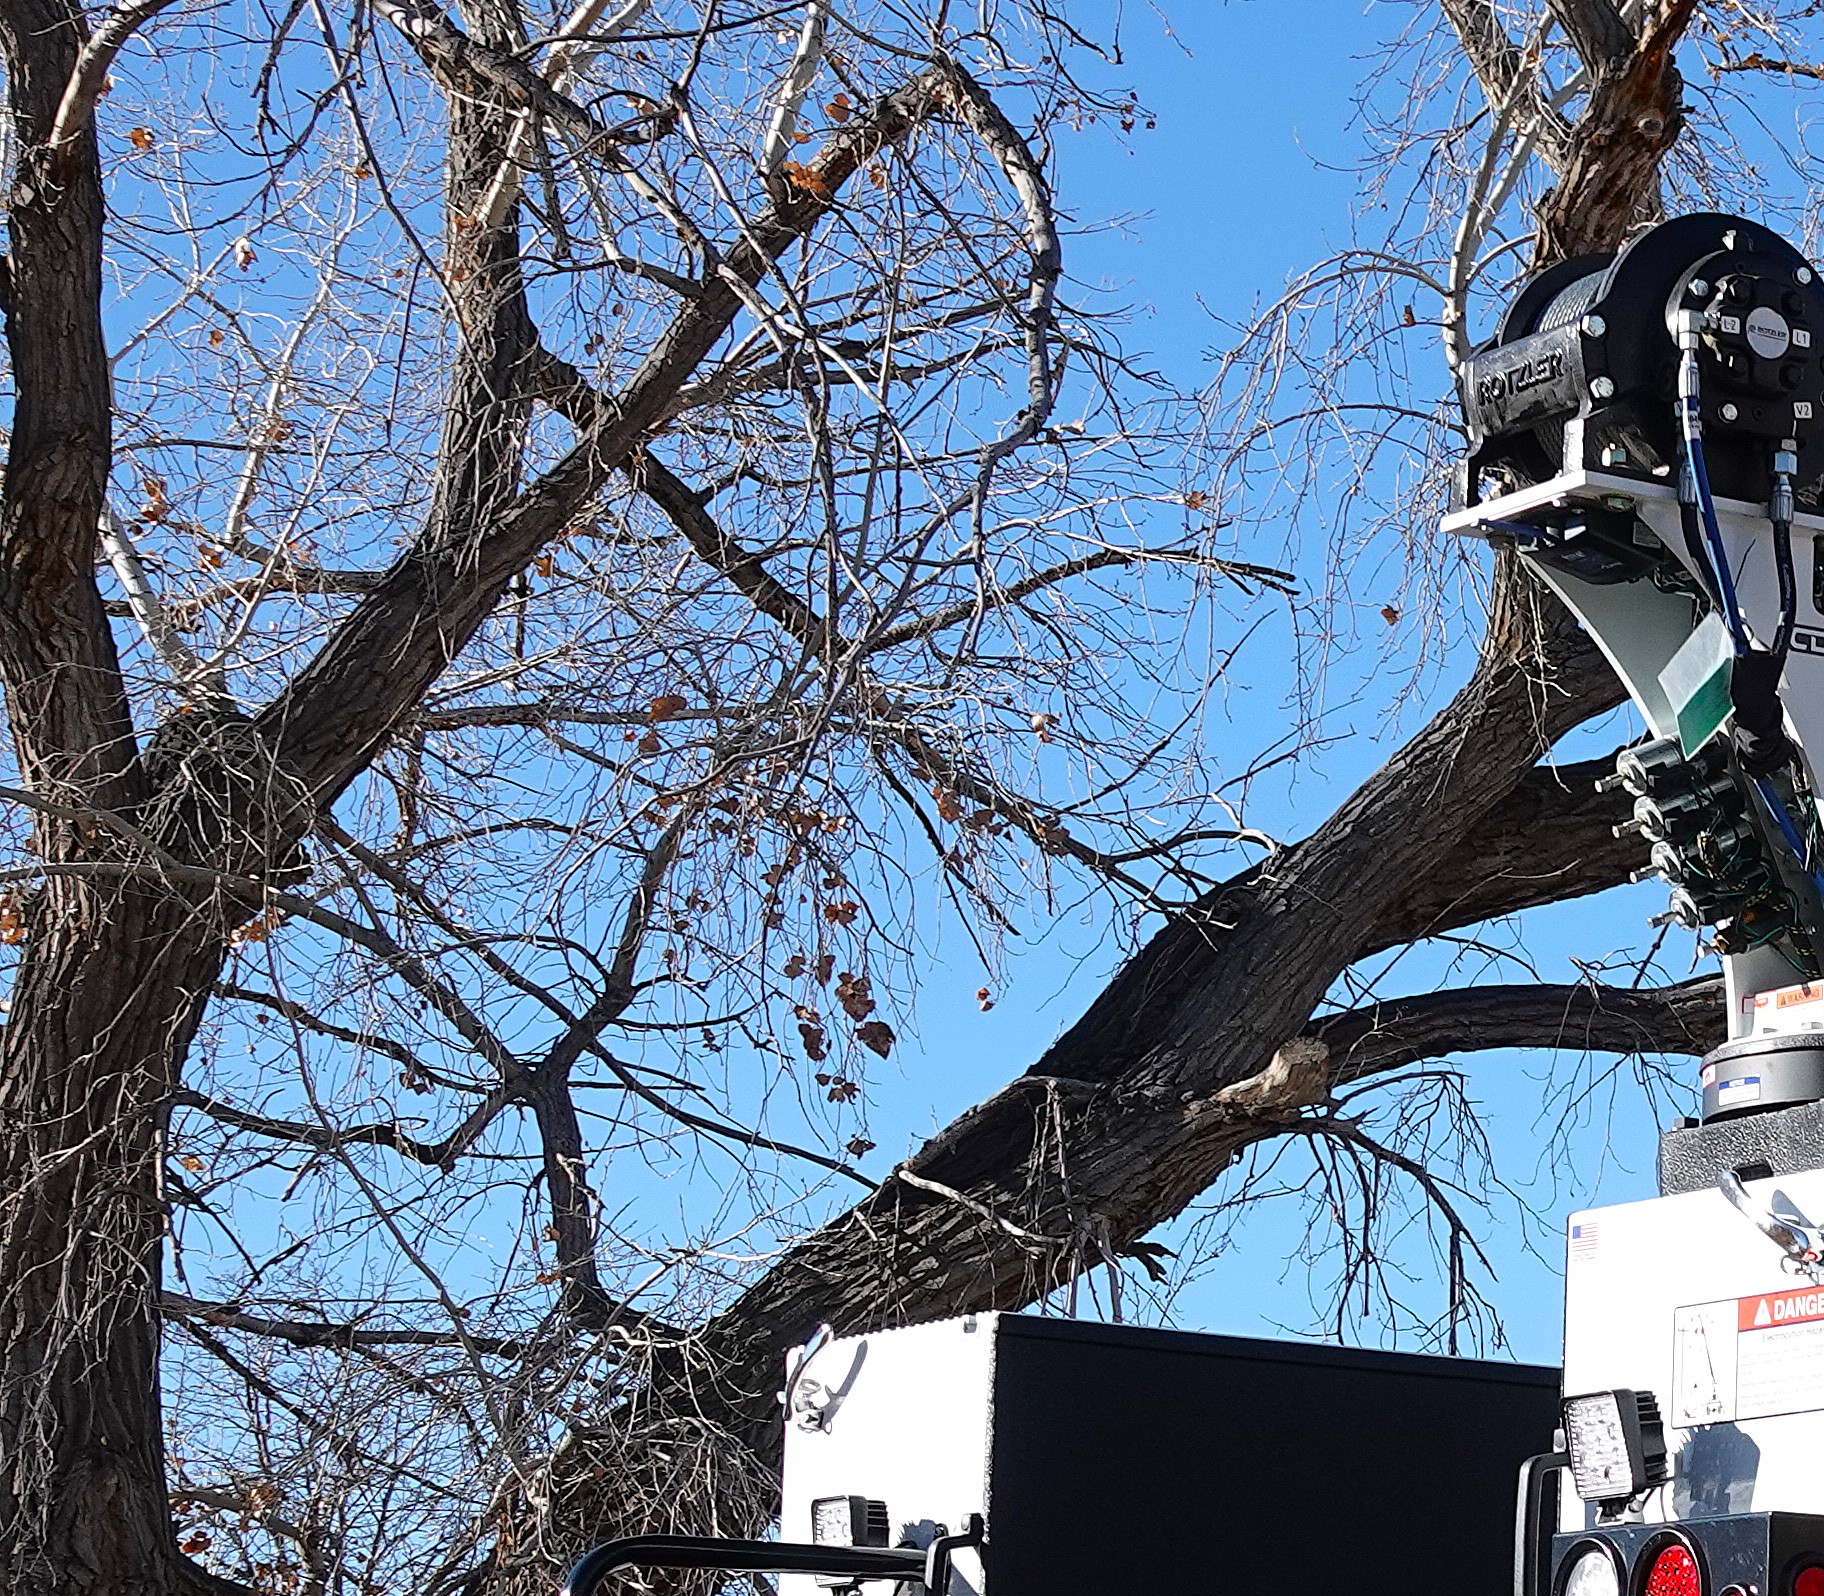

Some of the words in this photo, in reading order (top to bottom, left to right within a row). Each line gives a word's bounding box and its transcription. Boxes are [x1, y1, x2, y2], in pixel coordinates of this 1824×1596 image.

[1796, 332, 1807, 344] L1
[1478, 351, 1565, 402] ROTZLER
[1795, 404, 1810, 416] V2
